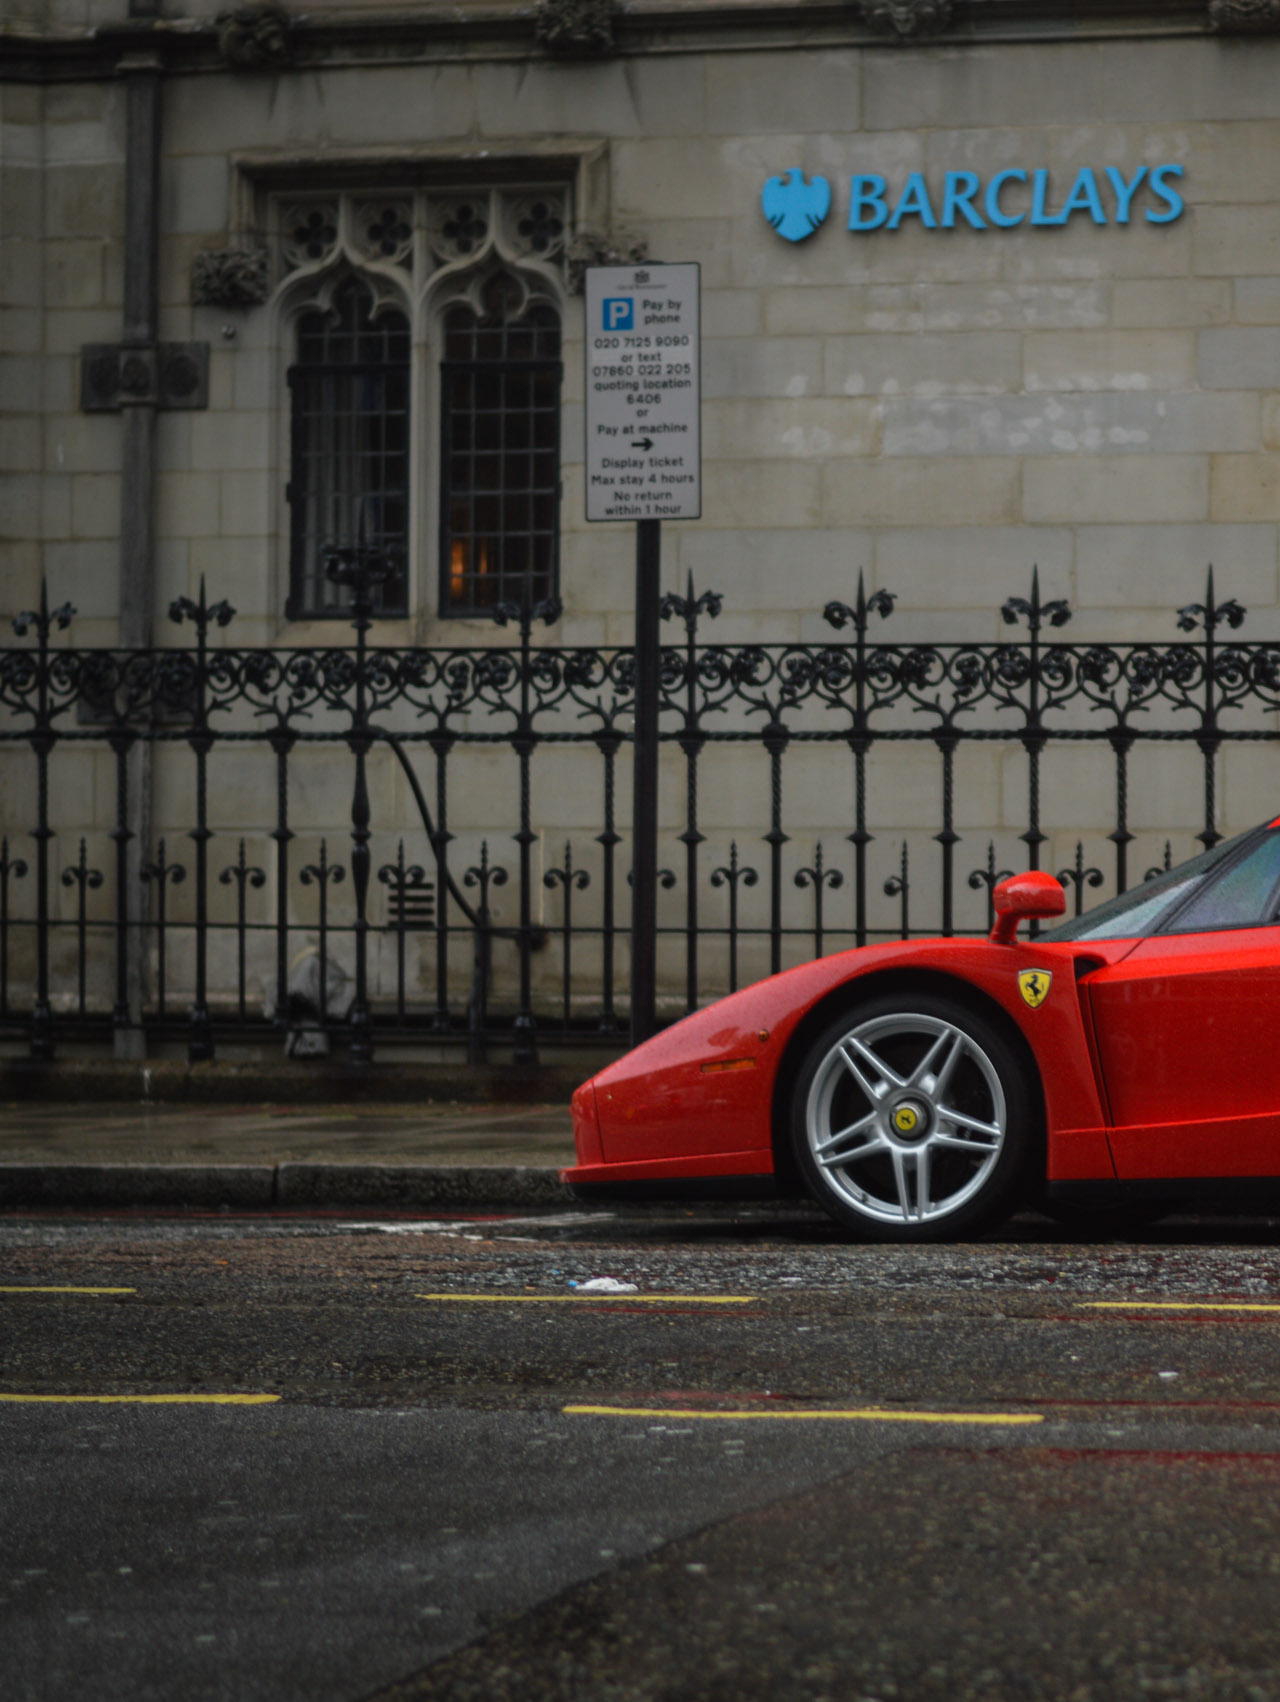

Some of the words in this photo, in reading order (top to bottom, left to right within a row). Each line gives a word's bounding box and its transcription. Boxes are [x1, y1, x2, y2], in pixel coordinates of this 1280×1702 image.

[847, 164, 1185, 231] BARCLAYS
[642, 299, 664, 311] Pay
[667, 298, 682, 311] by
[609, 301, 630, 328] P
[644, 313, 681, 325] phone
[594, 337, 620, 349] 020
[624, 336, 651, 348] 7125
[655, 335, 690, 347] 9090
[621, 354, 633, 363] or
[637, 352, 662, 362] text
[592, 365, 634, 377] 07860
[638, 364, 662, 376] 022
[666, 363, 691, 375] 205
[594, 380, 640, 392] quoting
[643, 379, 692, 389] location
[626, 393, 662, 404] 6406
[636, 409, 649, 418] or
[597, 424, 619, 436] Pay
[622, 424, 635, 434] at
[639, 423, 688, 434] machine
[602, 457, 645, 469] Display
[649, 456, 684, 467] ticket
[591, 475, 616, 485] Max
[620, 475, 645, 486] stay
[648, 474, 657, 483] 4
[661, 474, 695, 484] hours
[614, 491, 631, 501] No
[635, 491, 673, 501] return
[605, 505, 642, 515] within
[655, 505, 682, 514] hour
